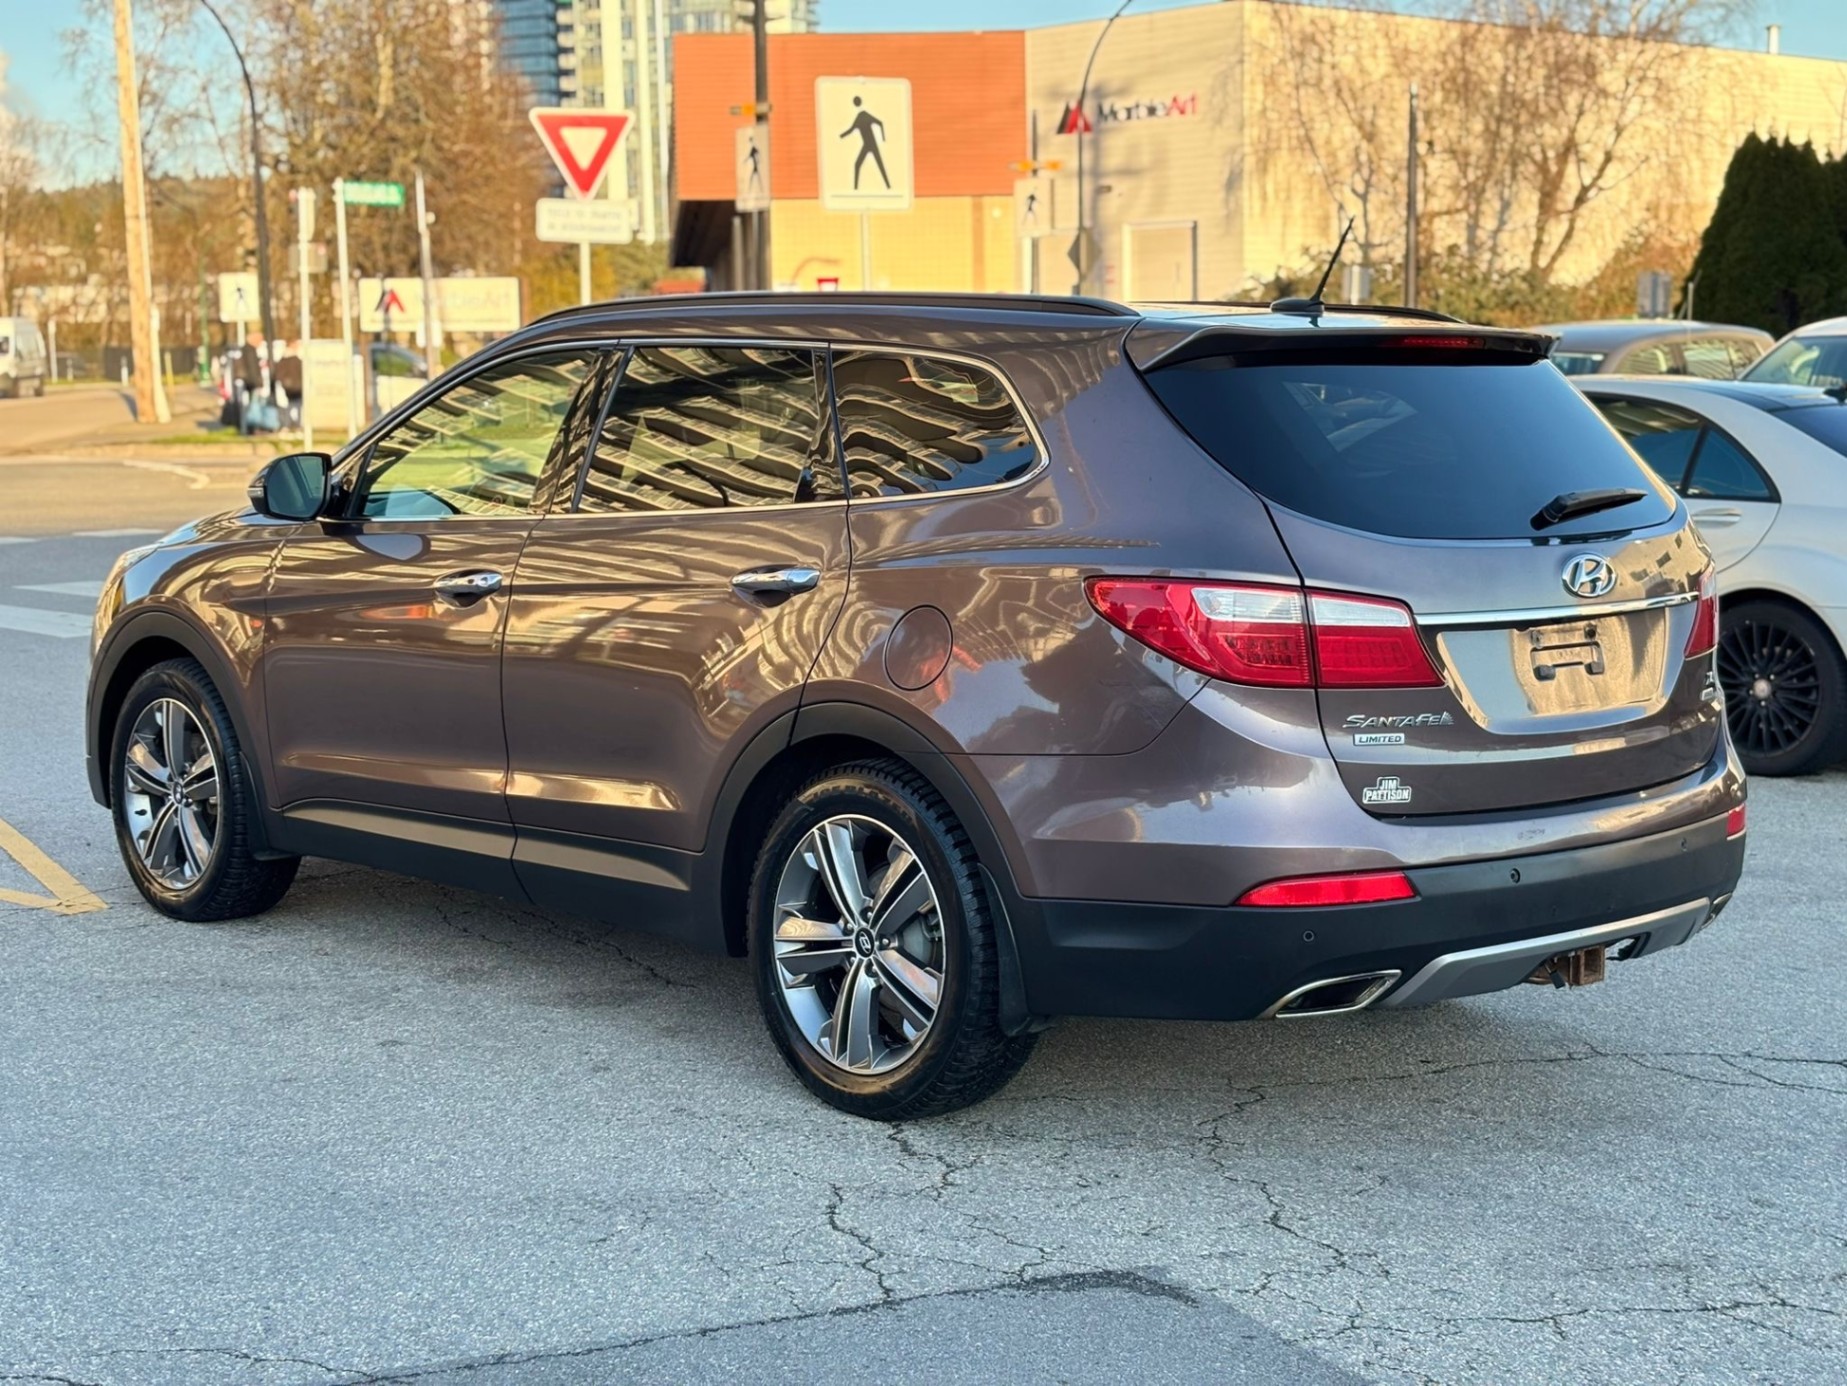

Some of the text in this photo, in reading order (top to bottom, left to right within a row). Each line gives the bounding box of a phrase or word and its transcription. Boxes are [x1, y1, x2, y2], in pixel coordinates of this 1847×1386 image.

[1358, 735, 1402, 743] LIMITED
[1379, 779, 1397, 789] JIM
[1365, 788, 1409, 801] PATTISON
